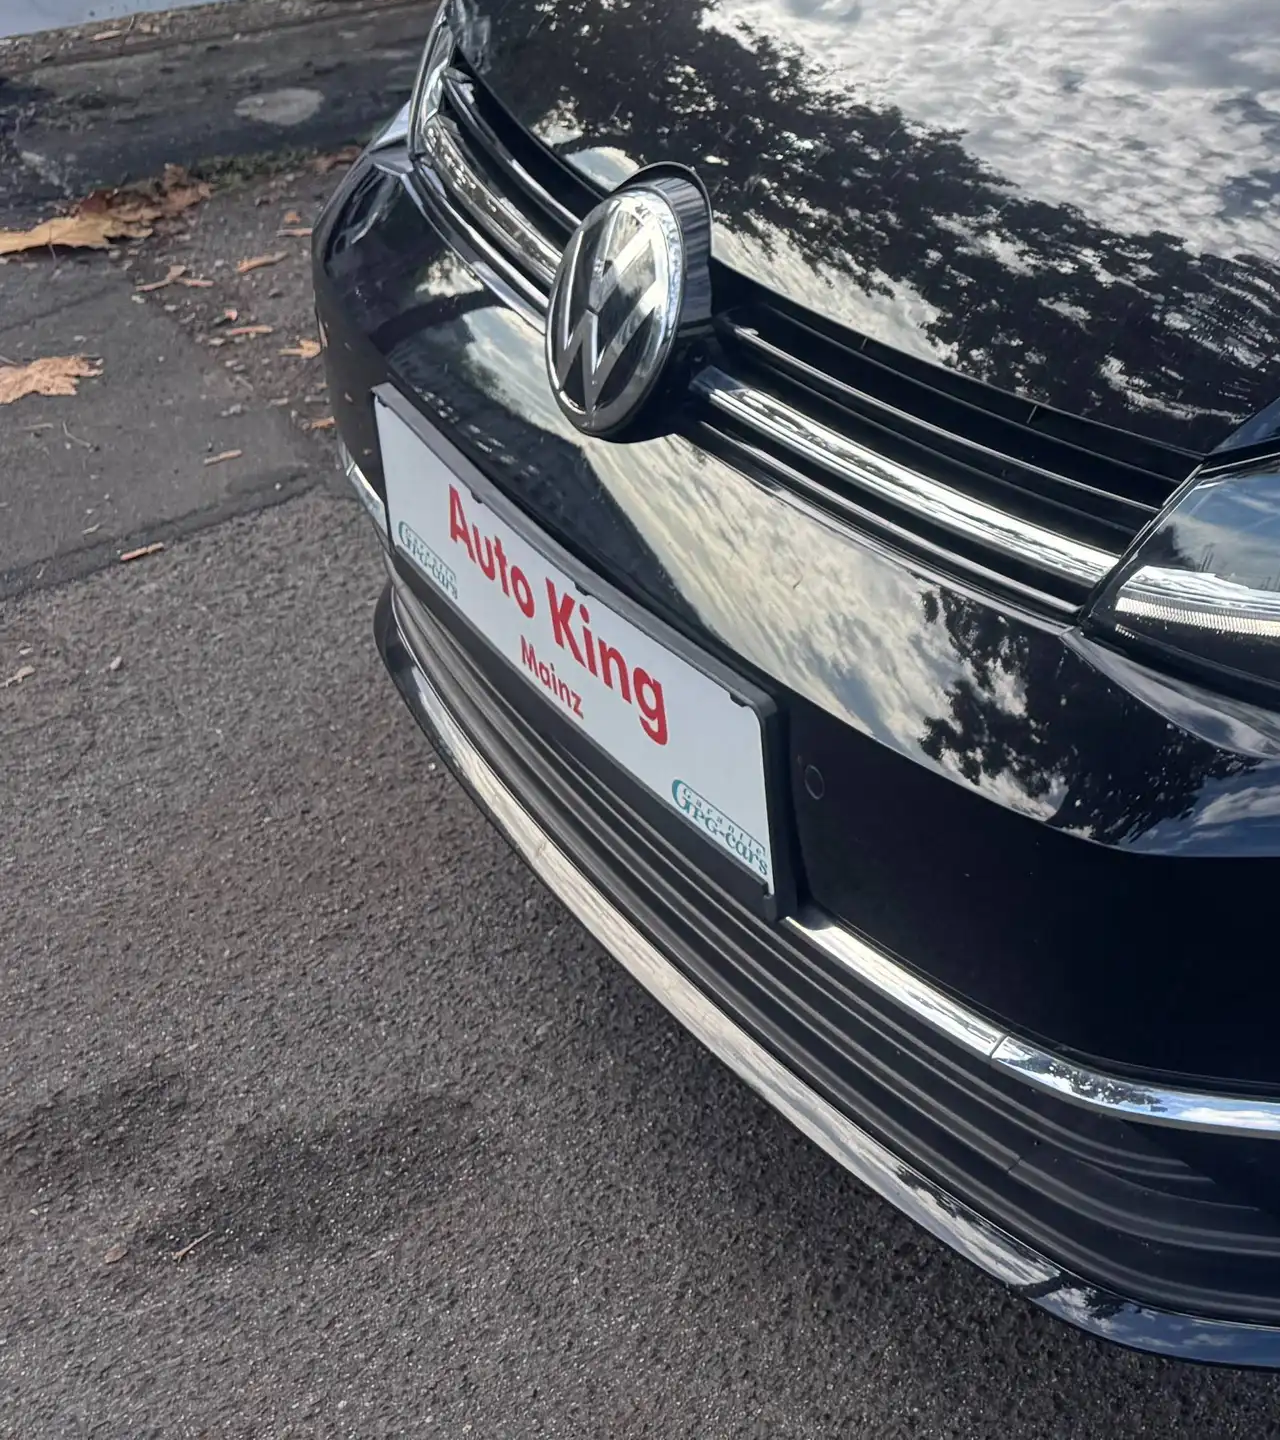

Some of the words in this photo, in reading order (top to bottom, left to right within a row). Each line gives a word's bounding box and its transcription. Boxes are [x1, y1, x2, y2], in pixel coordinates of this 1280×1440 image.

[448, 484, 535, 620] Auto
[545, 577, 668, 746] King
[520, 635, 584, 719] Mainz
